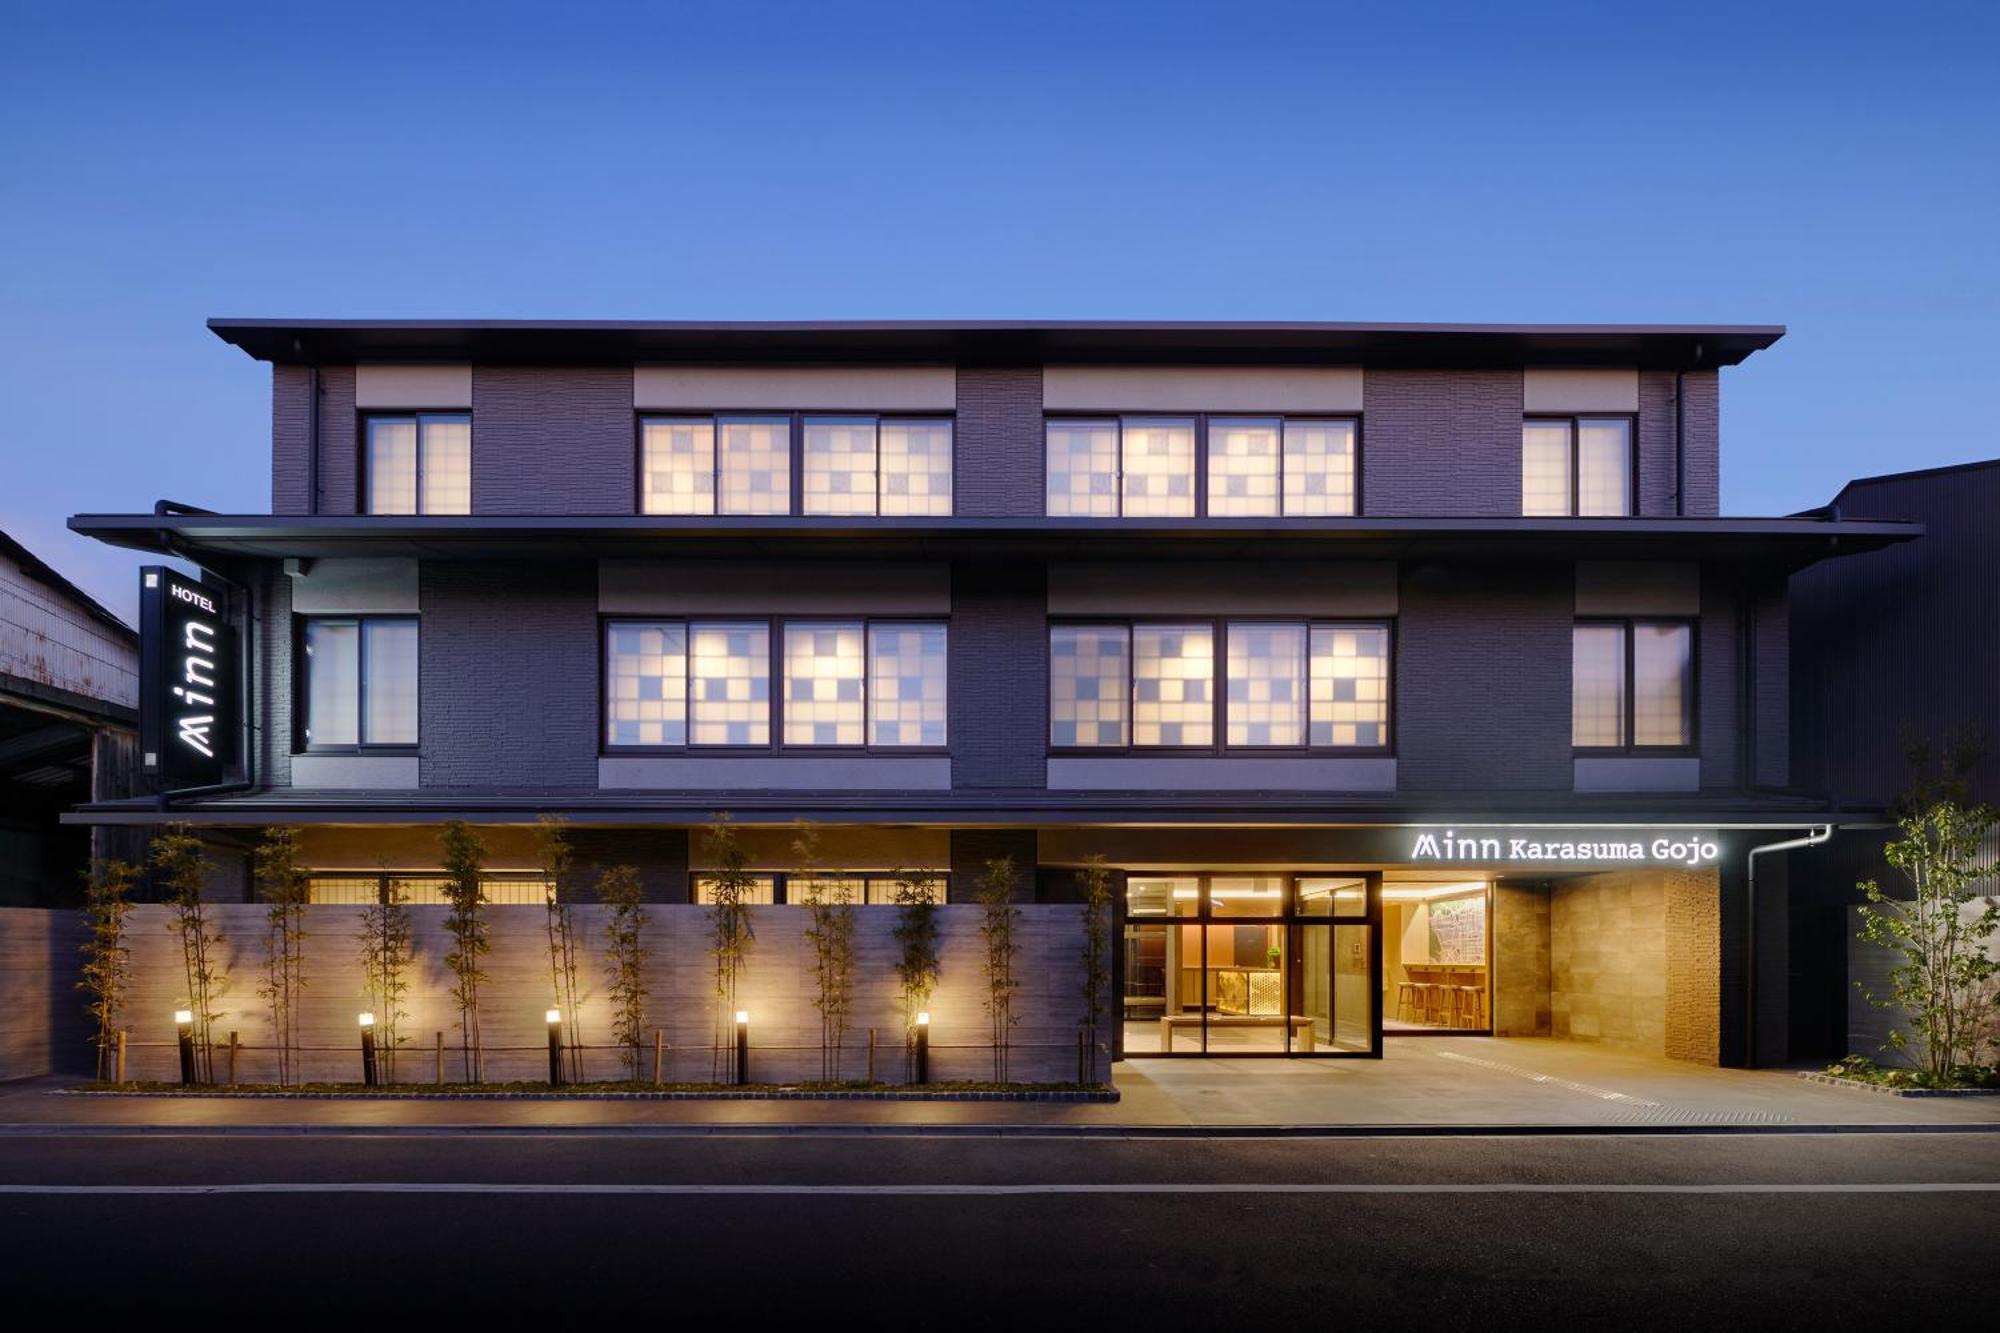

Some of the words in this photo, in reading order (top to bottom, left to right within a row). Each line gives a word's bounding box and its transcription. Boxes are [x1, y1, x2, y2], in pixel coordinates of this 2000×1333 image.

[171, 584, 217, 613] HOTEL
[1508, 838, 1646, 860] Karasuma
[1651, 837, 1719, 865] Gojo
